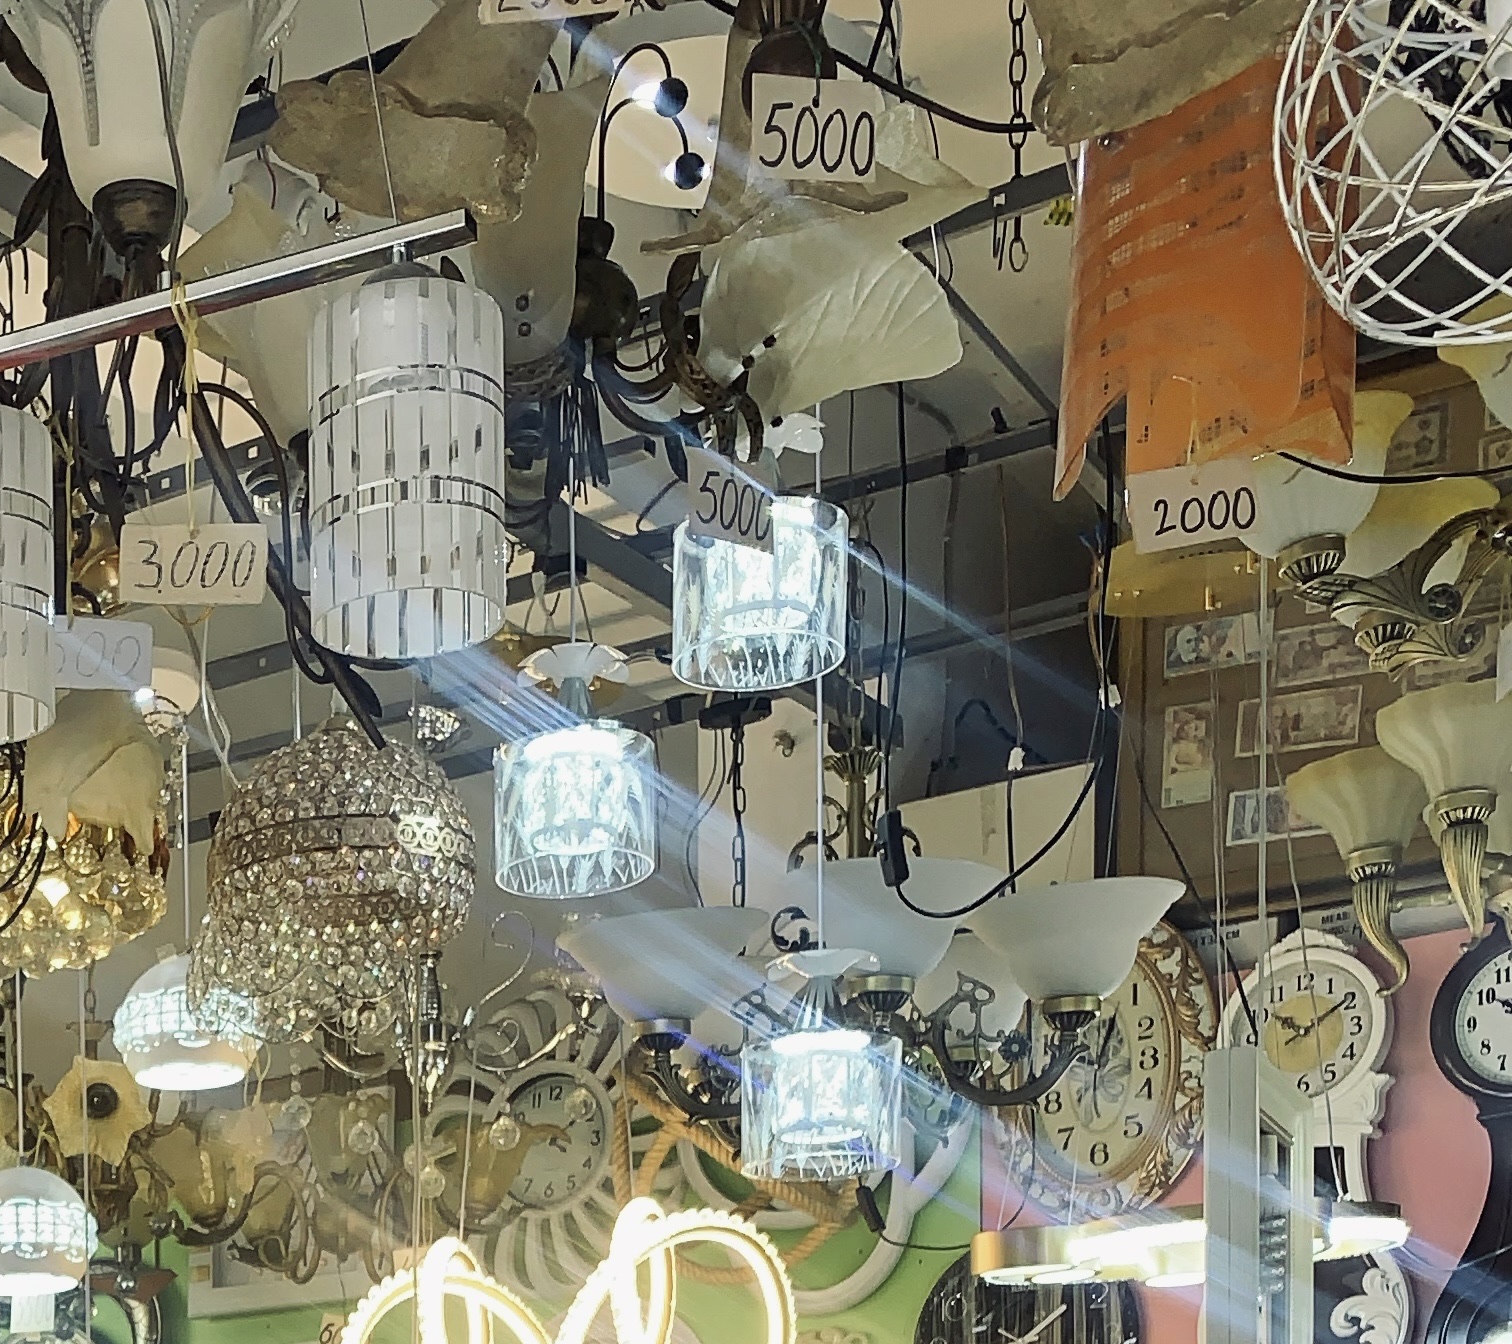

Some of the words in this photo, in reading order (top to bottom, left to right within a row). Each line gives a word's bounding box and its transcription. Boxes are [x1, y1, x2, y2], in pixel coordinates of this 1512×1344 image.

[759, 102, 876, 176] 5000
[696, 471, 774, 540] 5000
[1154, 487, 1255, 536] 2000
[1296, 973, 1314, 991] 12
[1496, 966, 1510, 985] 11
[1132, 983, 1138, 1006] 1
[1269, 986, 1284, 1003] 11
[1326, 978, 1334, 994] 1
[1344, 992, 1357, 1010] 2
[1477, 987, 1496, 1006] 10
[1138, 1016, 1154, 1041] 2
[1350, 1016, 1362, 1036] 3
[1467, 1016, 1477, 1033] 9
[1342, 1043, 1356, 1060] 4
[1480, 1039, 1491, 1056] 8
[1139, 1046, 1159, 1070] 3
[1497, 1054, 1507, 1071] 7
[1324, 1063, 1336, 1083] 5
[549, 1085, 563, 1101] 12
[1135, 1077, 1152, 1099] 4
[1297, 1074, 1310, 1093] 6
[532, 1092, 542, 1109] 11
[1044, 1091, 1062, 1114] 8
[1123, 1114, 1143, 1138] 5
[590, 1130, 600, 1146] 3
[1057, 1127, 1075, 1150] 7
[583, 1156, 592, 1169] 4
[1090, 1142, 1109, 1166] 6
[524, 1178, 533, 1194] 7
[544, 1181, 554, 1198] 6
[567, 1175, 576, 1190] 5
